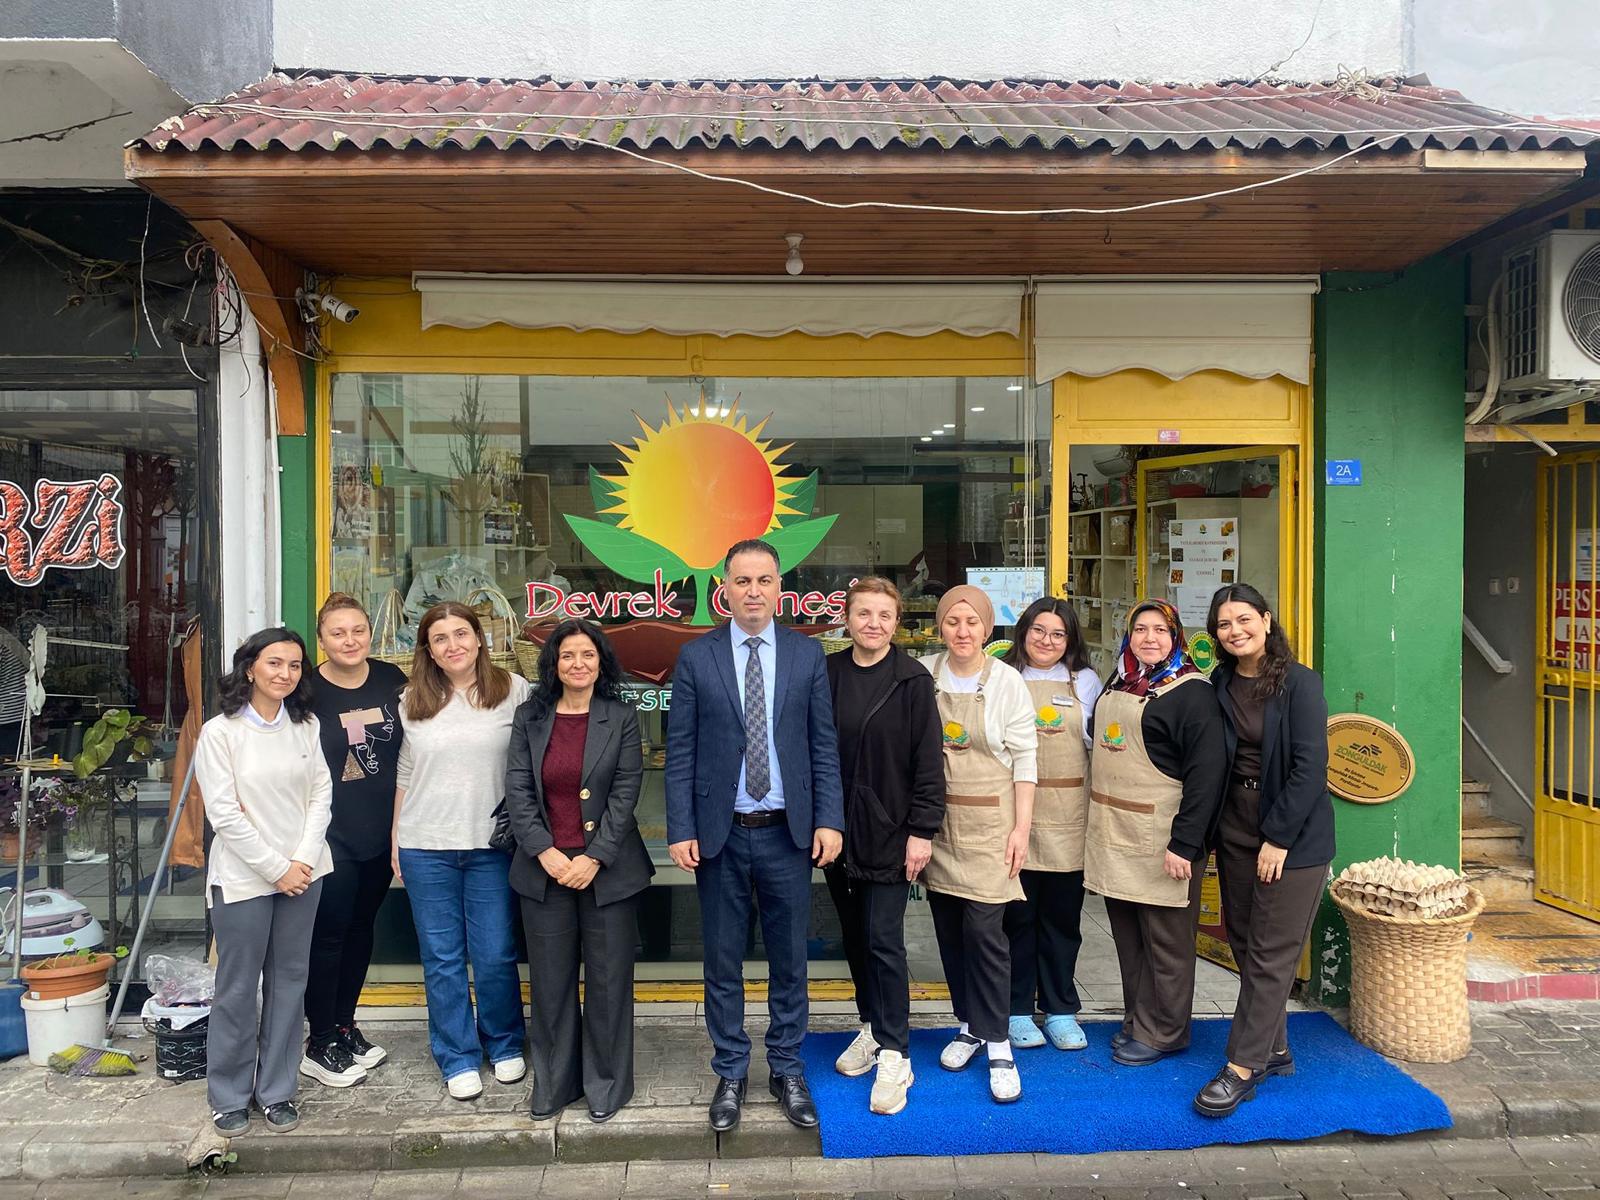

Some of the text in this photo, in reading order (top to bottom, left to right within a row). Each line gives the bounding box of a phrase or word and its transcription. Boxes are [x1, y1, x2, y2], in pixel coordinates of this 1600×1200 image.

[1336, 464, 1352, 476] 2A
[525, 568, 681, 618] Devrek
[1336, 745, 1387, 773] ZONGULDAK
